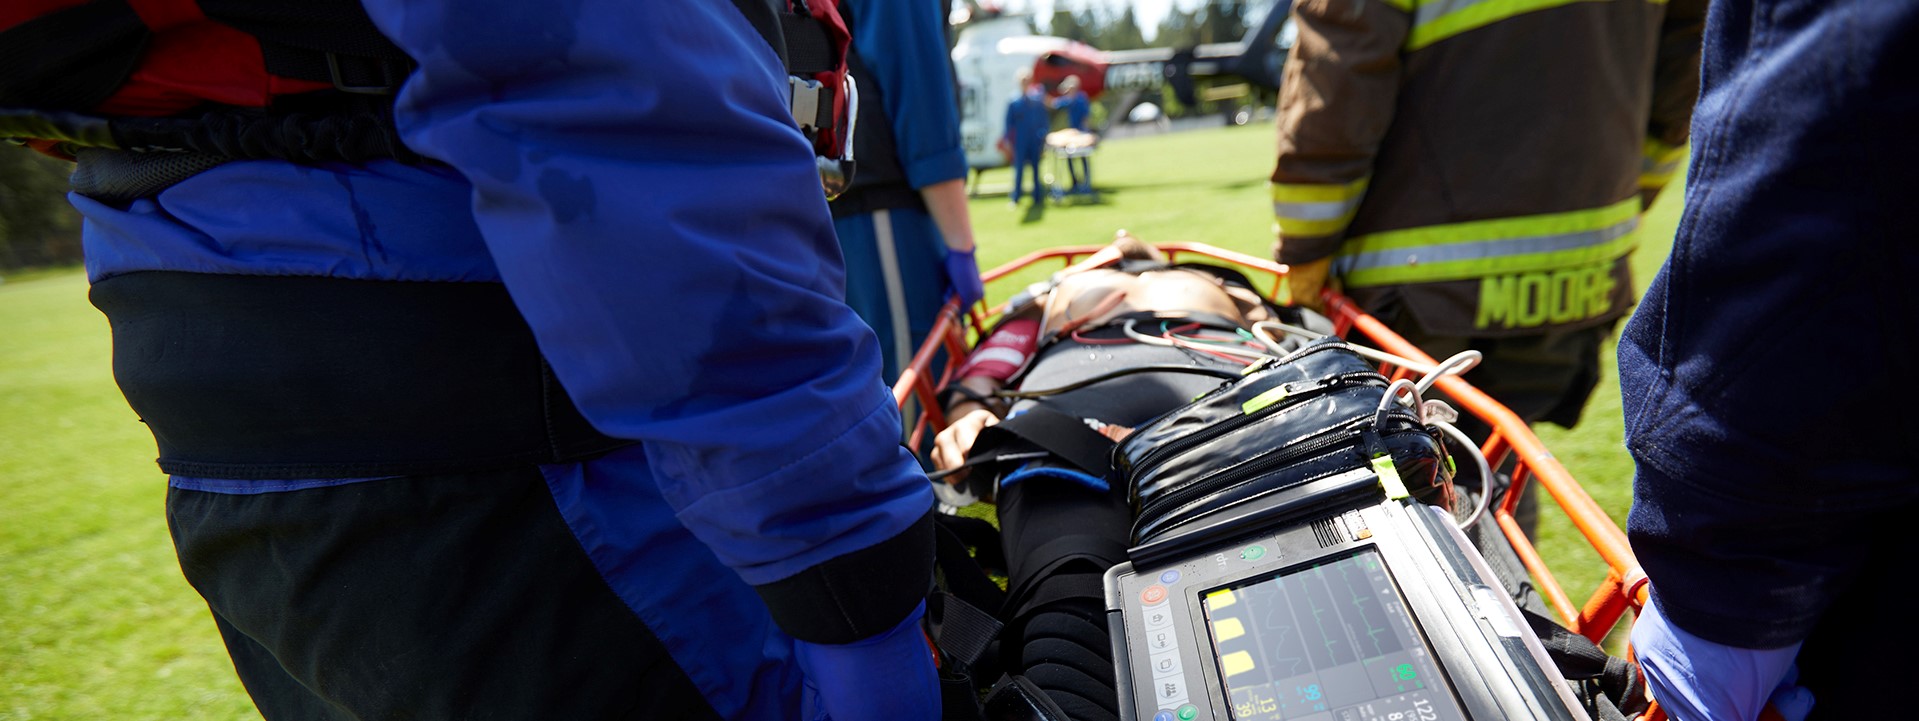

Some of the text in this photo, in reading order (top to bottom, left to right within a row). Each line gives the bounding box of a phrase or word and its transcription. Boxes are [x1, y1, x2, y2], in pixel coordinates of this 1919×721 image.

[1475, 260, 1617, 330] MOORE
[1396, 663, 1417, 680] 60
[1303, 684, 1321, 700] 99
[1235, 702, 1252, 718] 39
[1260, 698, 1276, 713] 13
[1413, 699, 1437, 721] 122
